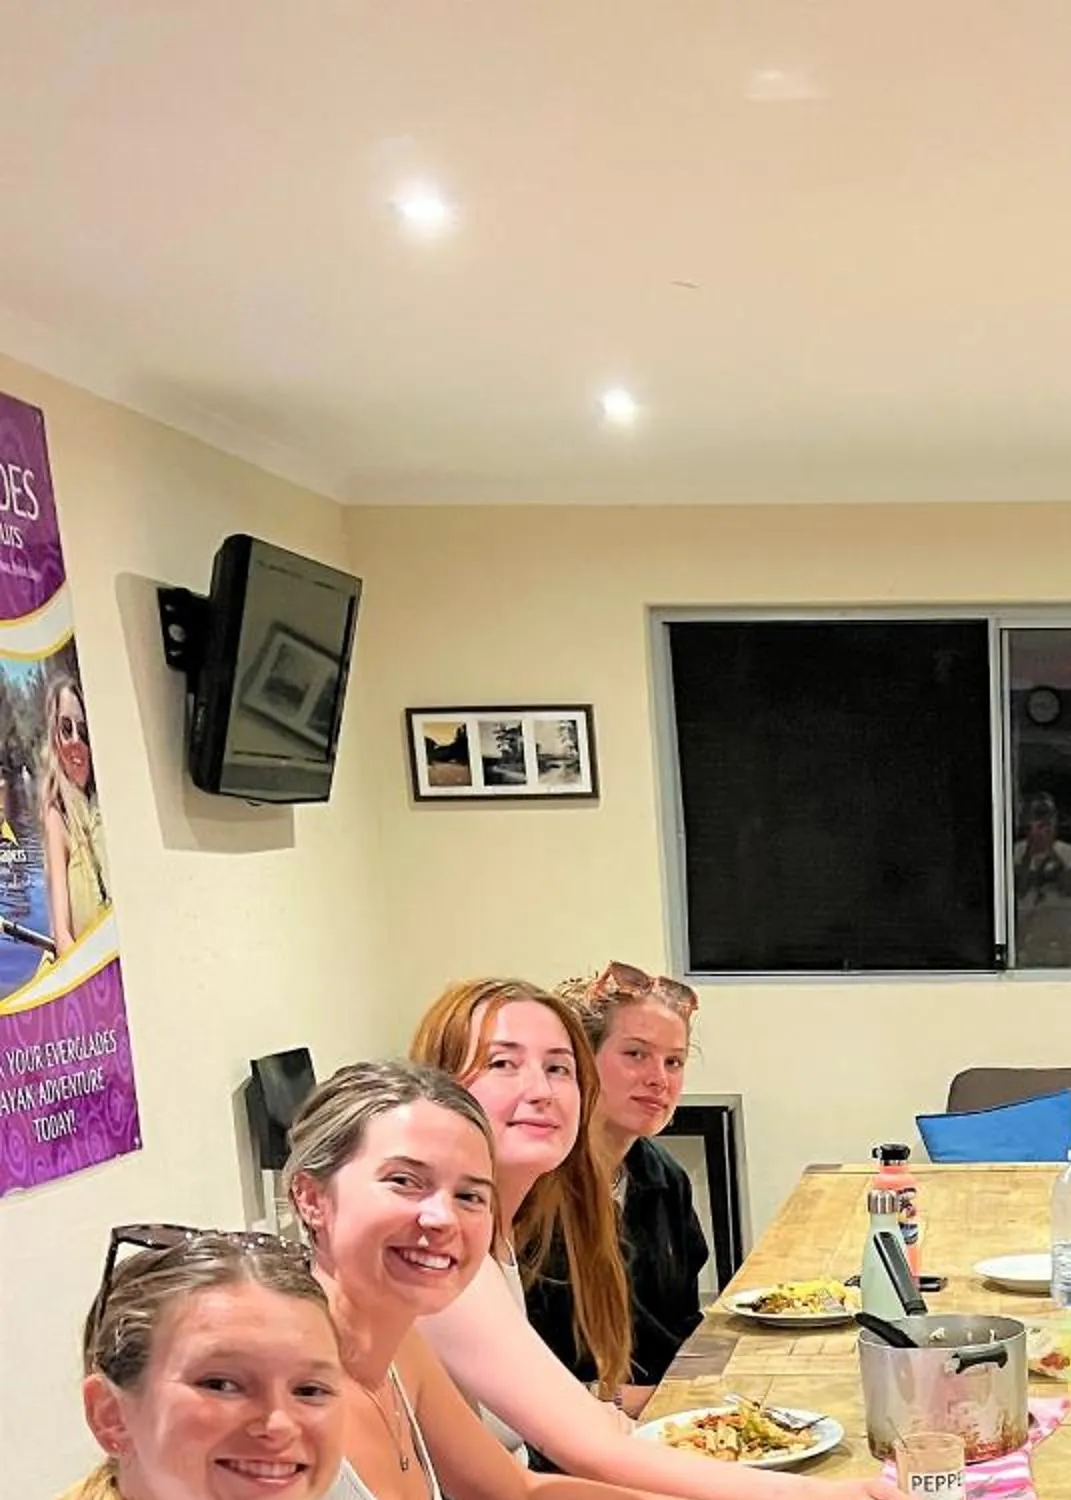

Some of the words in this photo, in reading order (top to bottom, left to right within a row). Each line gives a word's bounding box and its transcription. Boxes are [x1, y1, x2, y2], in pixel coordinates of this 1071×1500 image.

[6, 1045, 43, 1077] YOUR
[44, 1029, 117, 1068] EVERGLADES
[0, 1084, 35, 1117] AYAK
[39, 1067, 105, 1107] ADVENTURE
[32, 1109, 77, 1143] TODAY!
